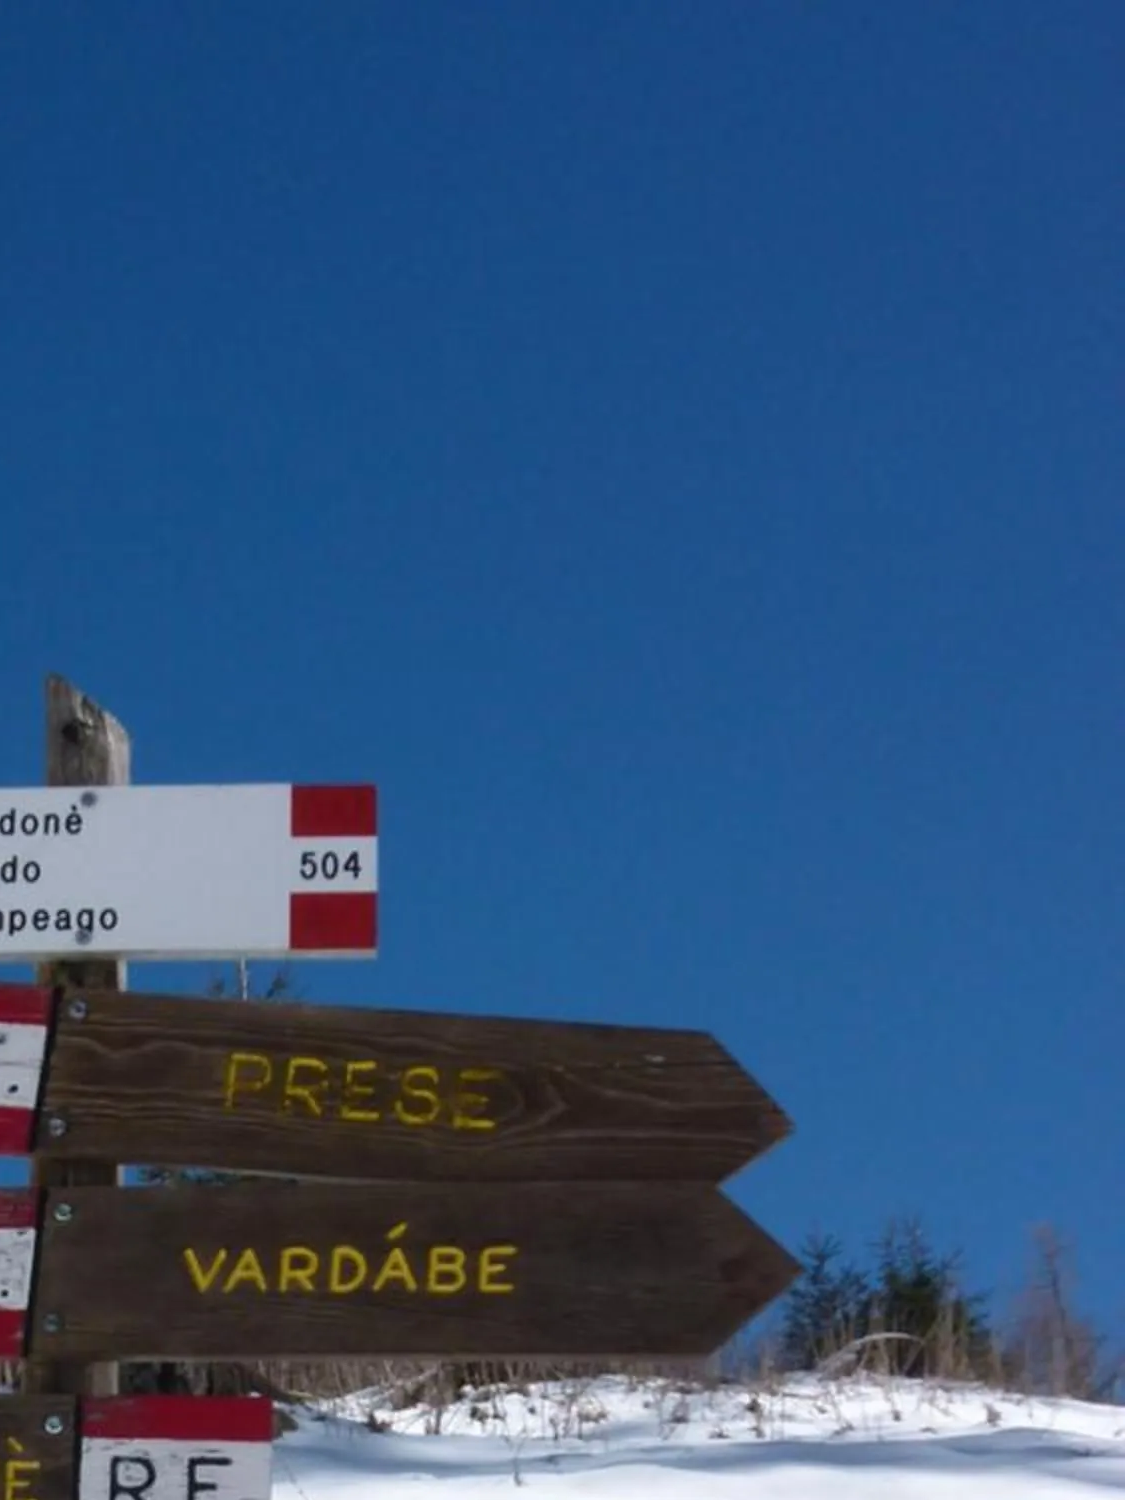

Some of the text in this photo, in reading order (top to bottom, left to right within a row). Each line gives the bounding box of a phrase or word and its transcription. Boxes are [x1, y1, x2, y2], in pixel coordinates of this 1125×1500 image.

[299, 851, 363, 880] 504
[223, 1052, 497, 1131] PRESE
[184, 1224, 518, 1295] VARDÁBE
